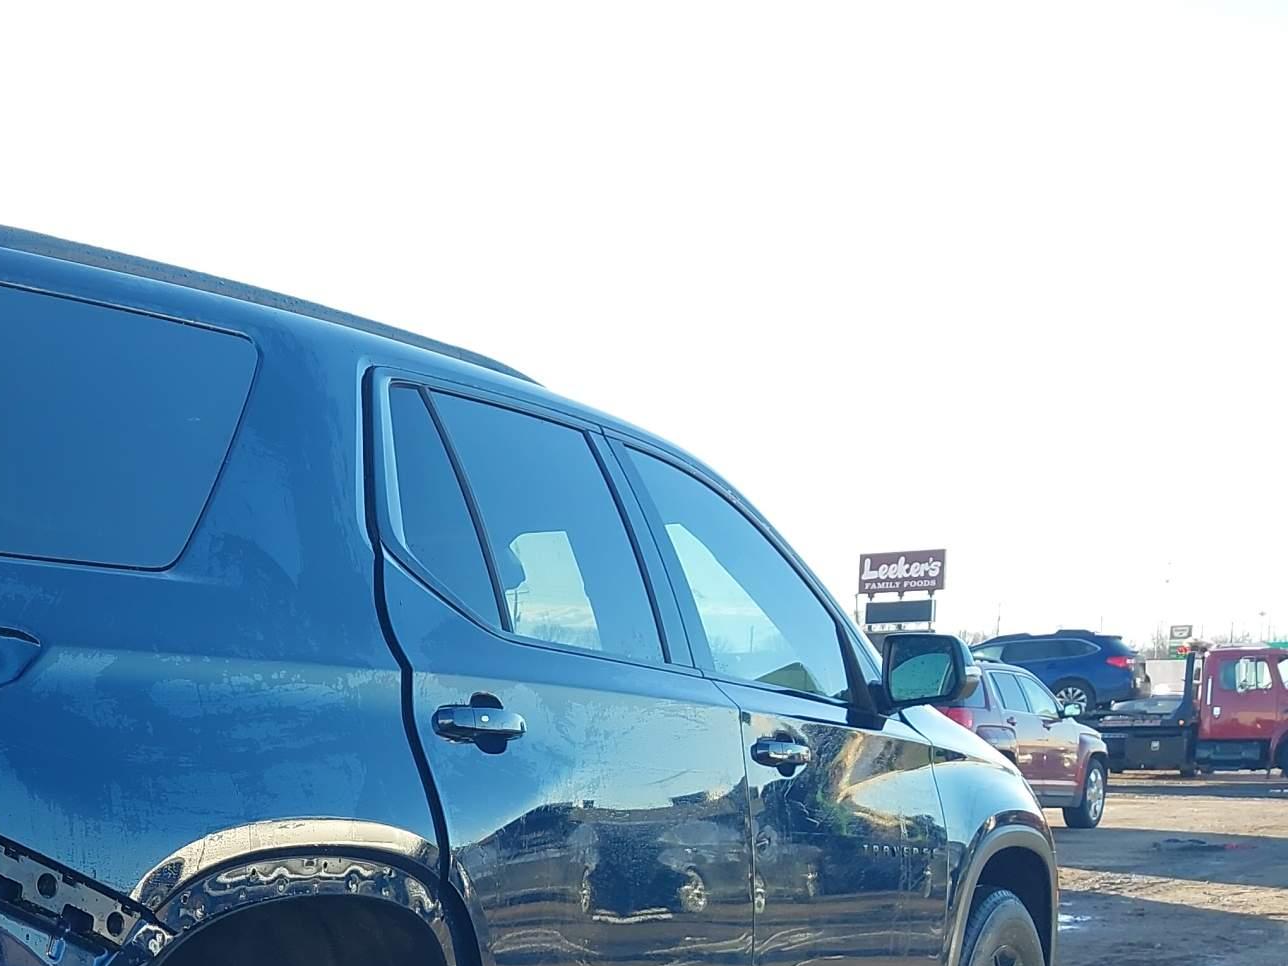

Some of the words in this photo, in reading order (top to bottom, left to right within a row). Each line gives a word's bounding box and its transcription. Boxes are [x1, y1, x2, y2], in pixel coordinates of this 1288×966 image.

[861, 556, 942, 580] Leeker's
[864, 581, 901, 589] FAMILY
[903, 579, 937, 588] FOODS
